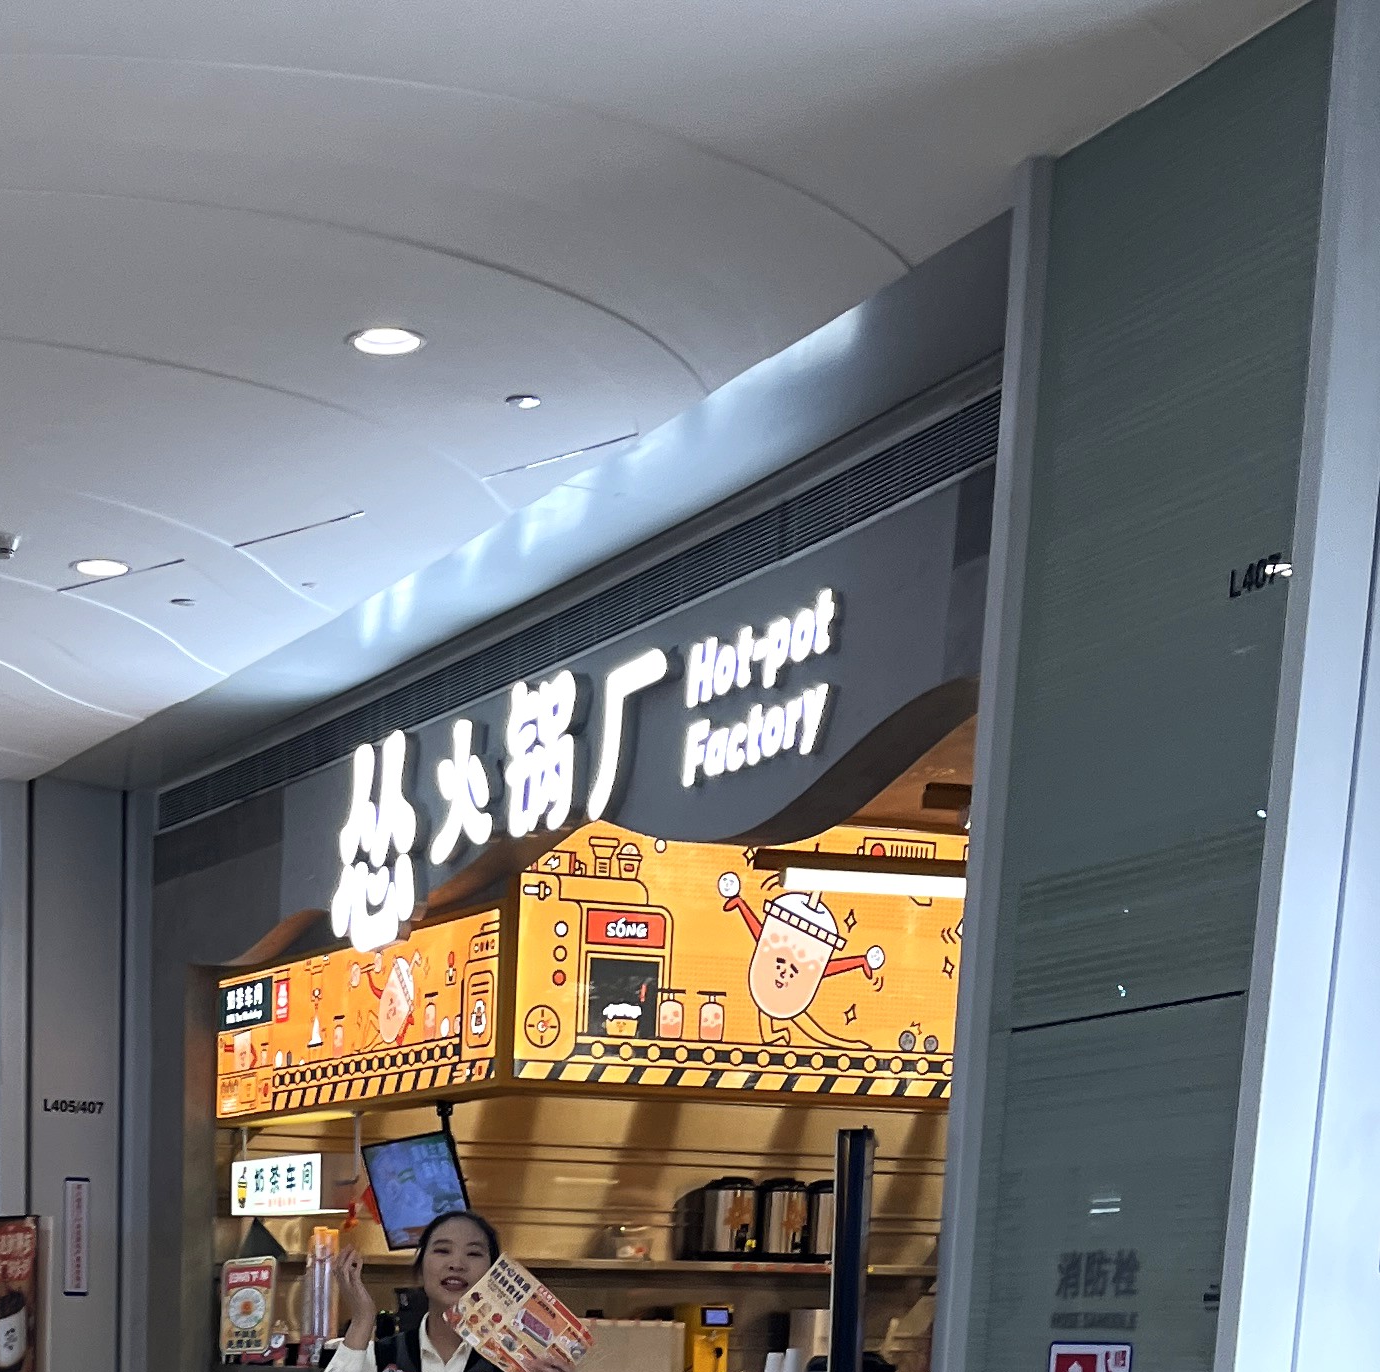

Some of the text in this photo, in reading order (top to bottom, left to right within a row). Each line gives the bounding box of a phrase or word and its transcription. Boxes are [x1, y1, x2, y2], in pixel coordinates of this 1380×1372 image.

[686, 587, 836, 709] Hot-pot
[681, 683, 830, 788] Factory
[331, 648, 668, 953] 怂火锅厂
[42, 1098, 104, 1115] L405/407
[254, 1161, 313, 1194] 奶茶车间
